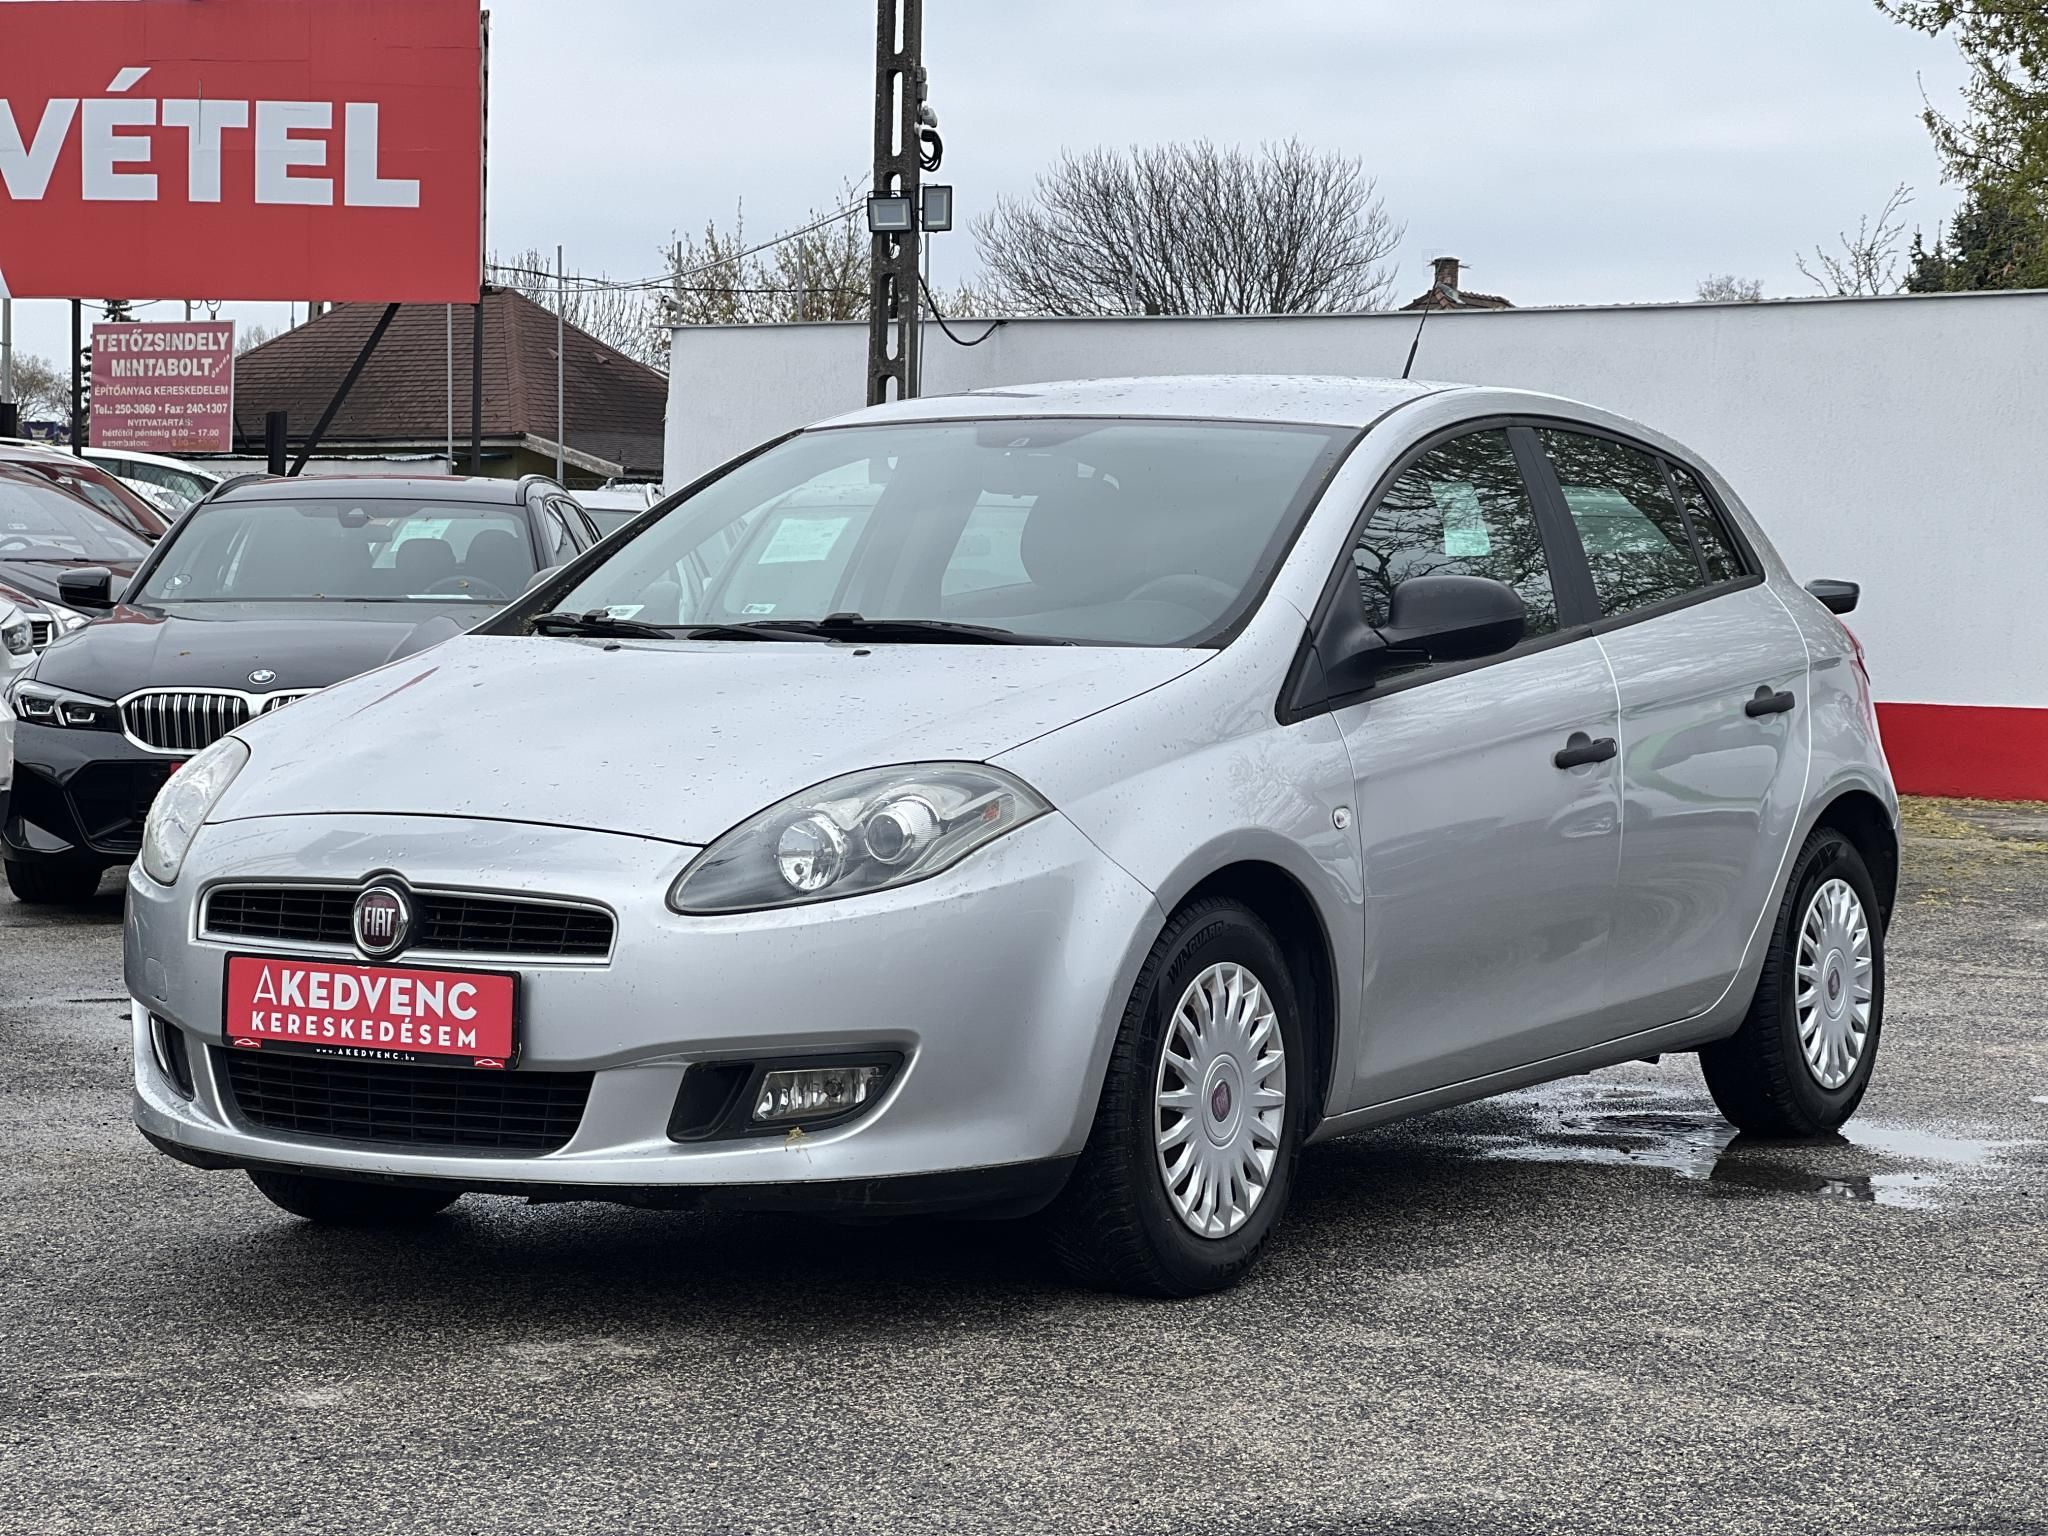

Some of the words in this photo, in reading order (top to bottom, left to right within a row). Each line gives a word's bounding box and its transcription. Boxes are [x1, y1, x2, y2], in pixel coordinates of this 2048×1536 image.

[0, 67, 420, 207] VÉTEL
[96, 329, 229, 352] TETŐZSINDELY
[111, 358, 213, 377] MINTABOLT
[94, 384, 152, 396] ÉPÍTŐANYAG
[154, 385, 228, 395] KERESKEDELEM
[165, 403, 184, 414] Fax:
[187, 403, 228, 414] 240-1307
[363, 906, 396, 937] FIAT
[251, 1010, 476, 1049] KERESKEDÉSEM
